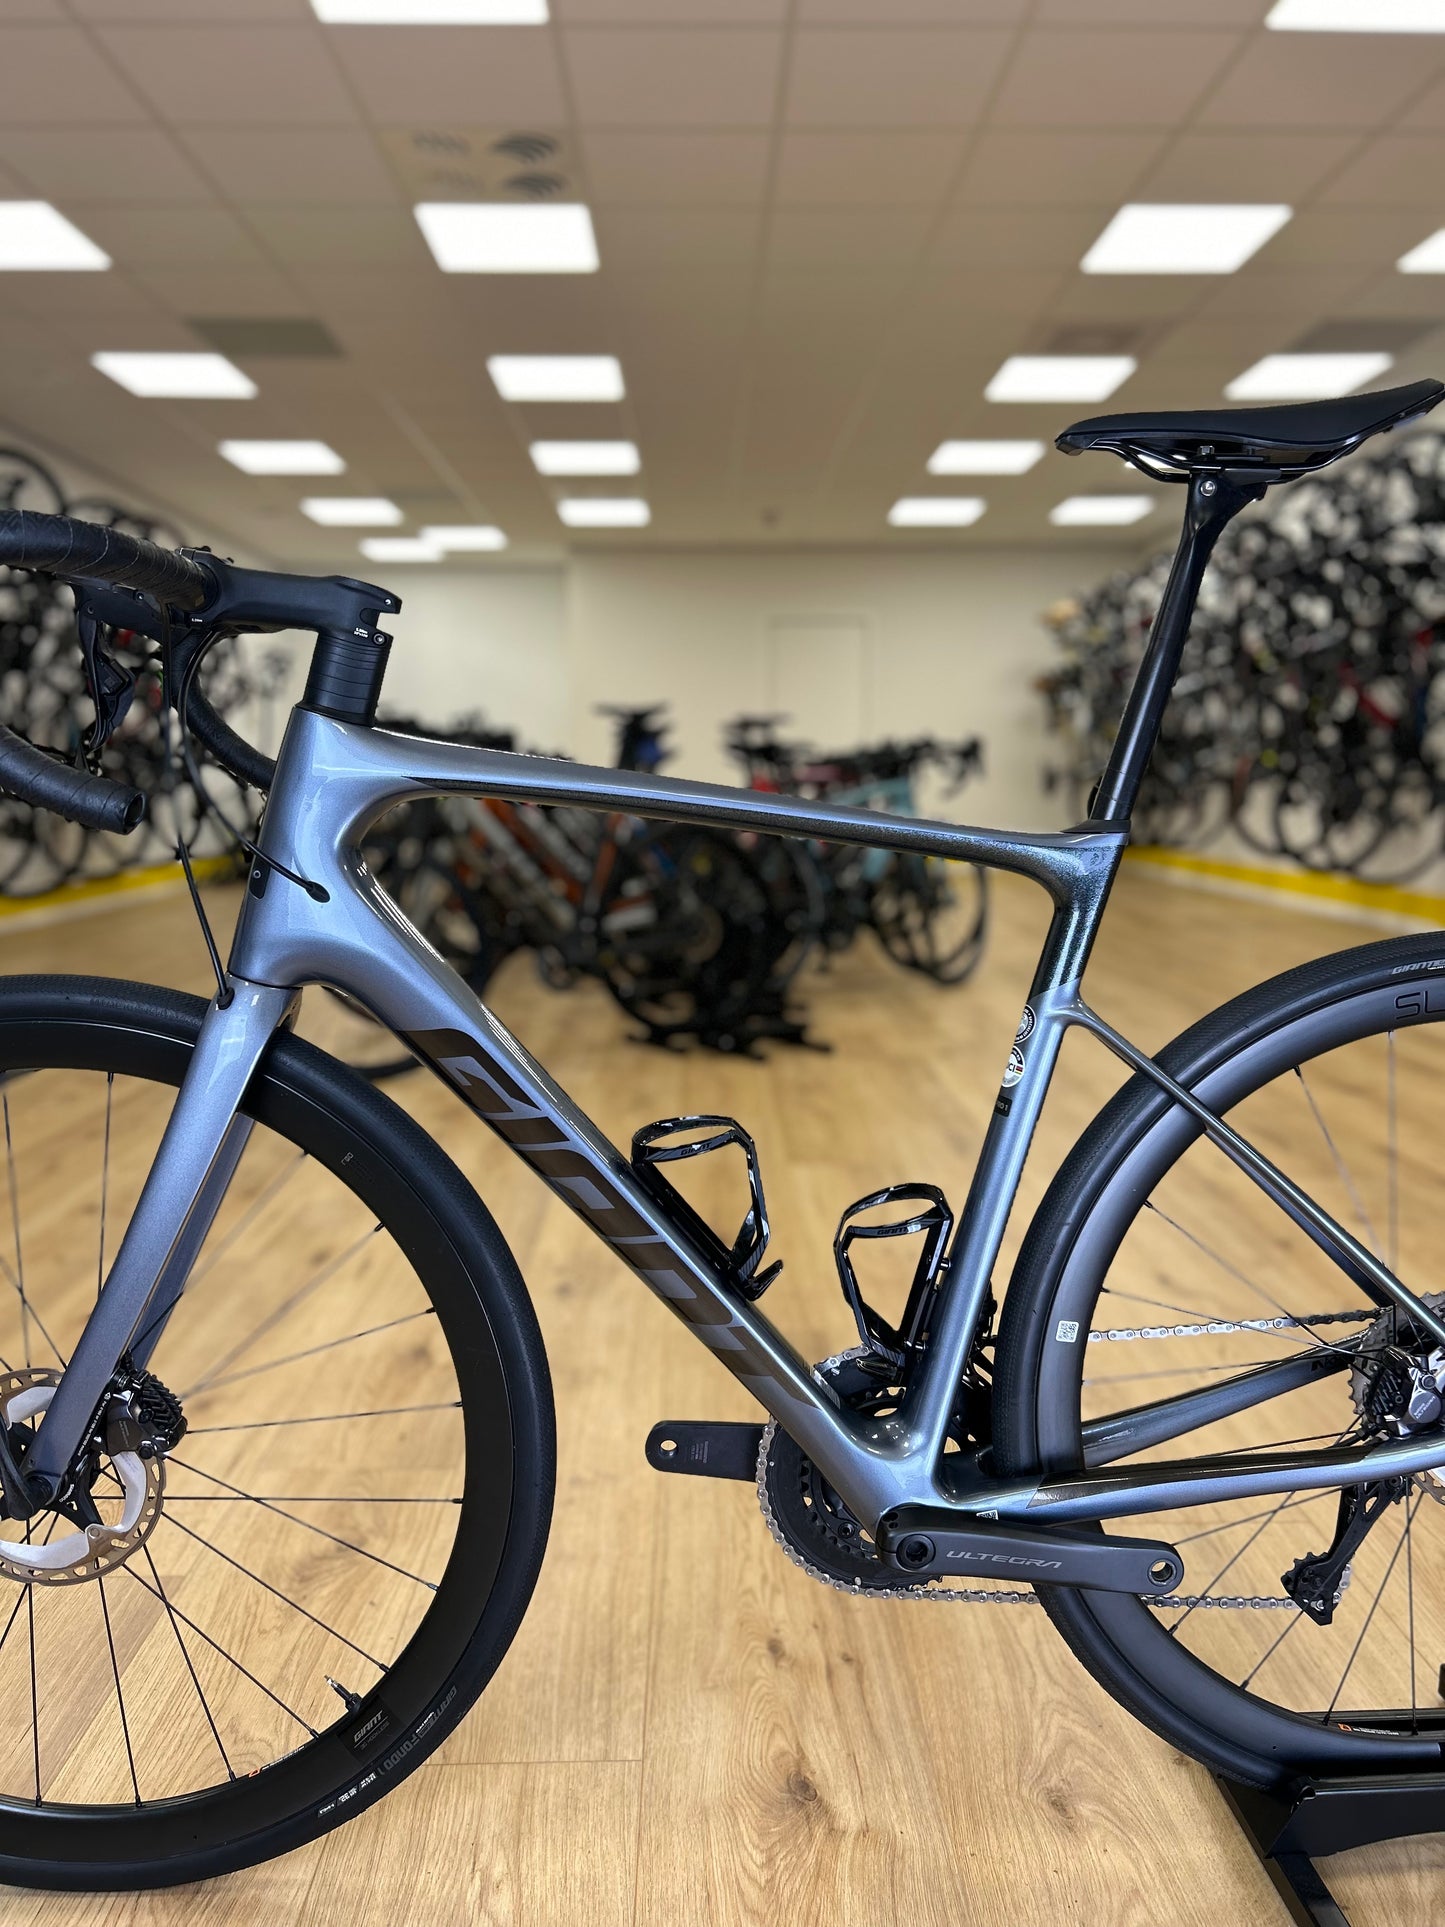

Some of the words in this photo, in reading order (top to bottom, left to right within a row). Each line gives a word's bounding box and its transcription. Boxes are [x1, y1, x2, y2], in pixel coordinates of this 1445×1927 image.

[946, 1550, 1063, 1569] ULTEGRA
[354, 1709, 383, 1742] GIANT
[383, 1733, 421, 1771] FONDO
